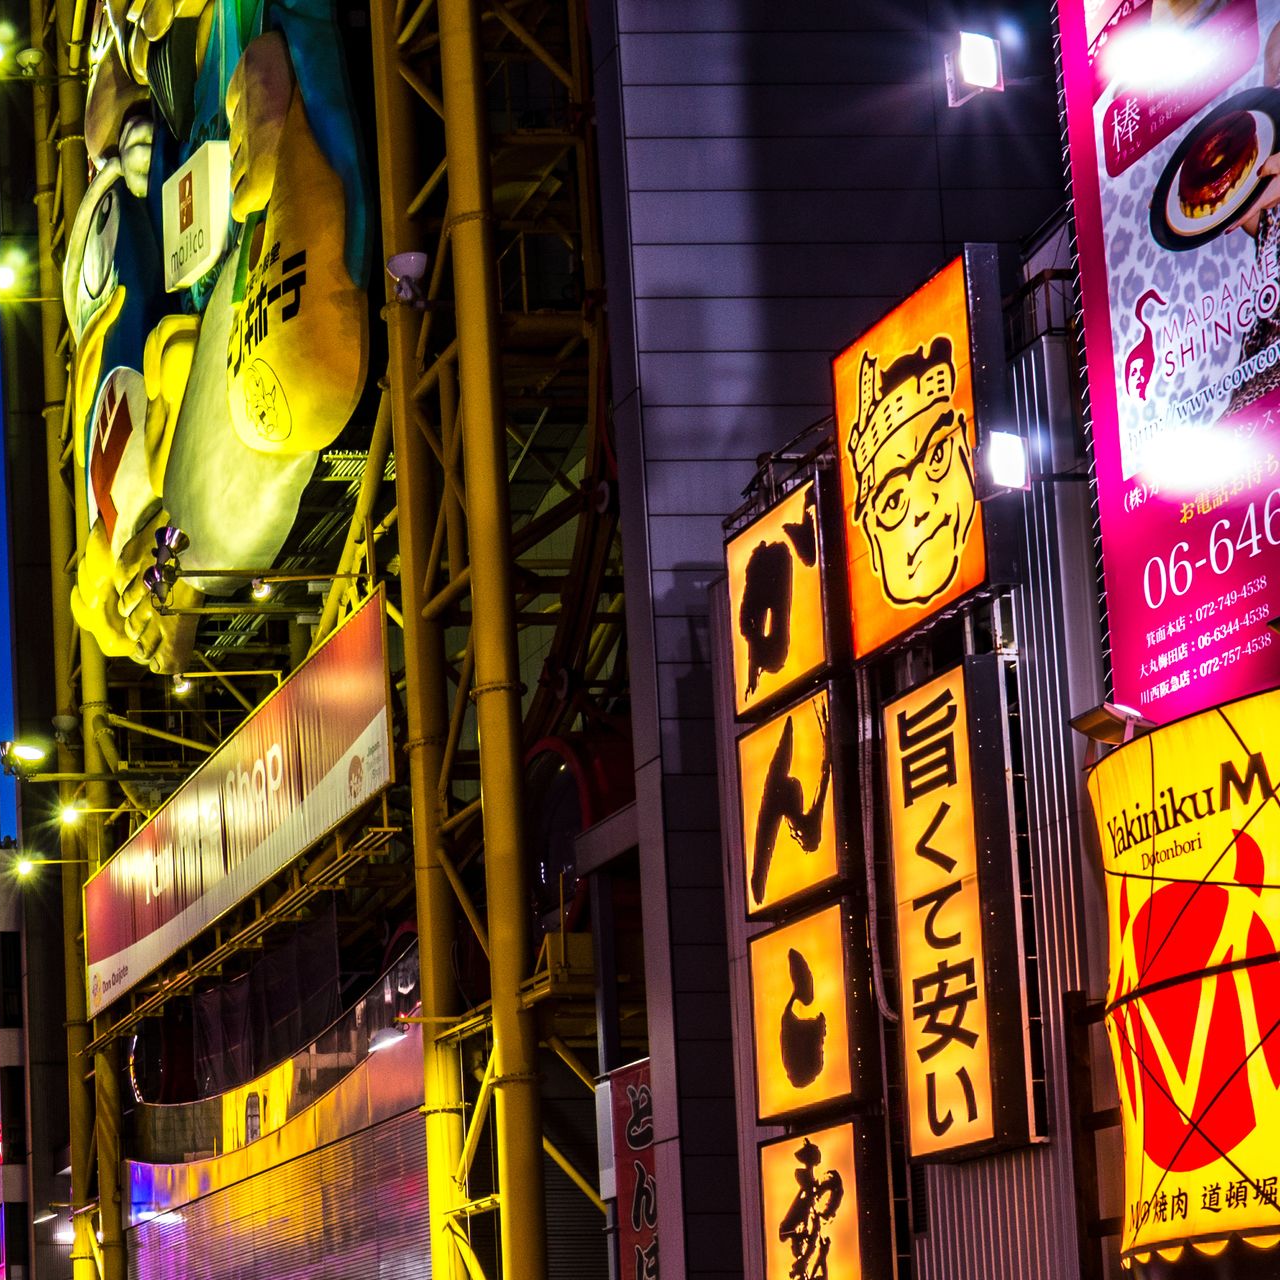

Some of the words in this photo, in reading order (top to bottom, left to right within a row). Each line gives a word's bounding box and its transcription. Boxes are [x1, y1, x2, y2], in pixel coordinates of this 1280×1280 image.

[1163, 250, 1277, 349] MADAME
[1165, 284, 1278, 377] SHINCO
[1107, 787, 1216, 859] Yakiniku
[1219, 751, 1275, 812] M
[1141, 832, 1203, 871] Dotonbori
[896, 688, 979, 1137] 旨くて安い
